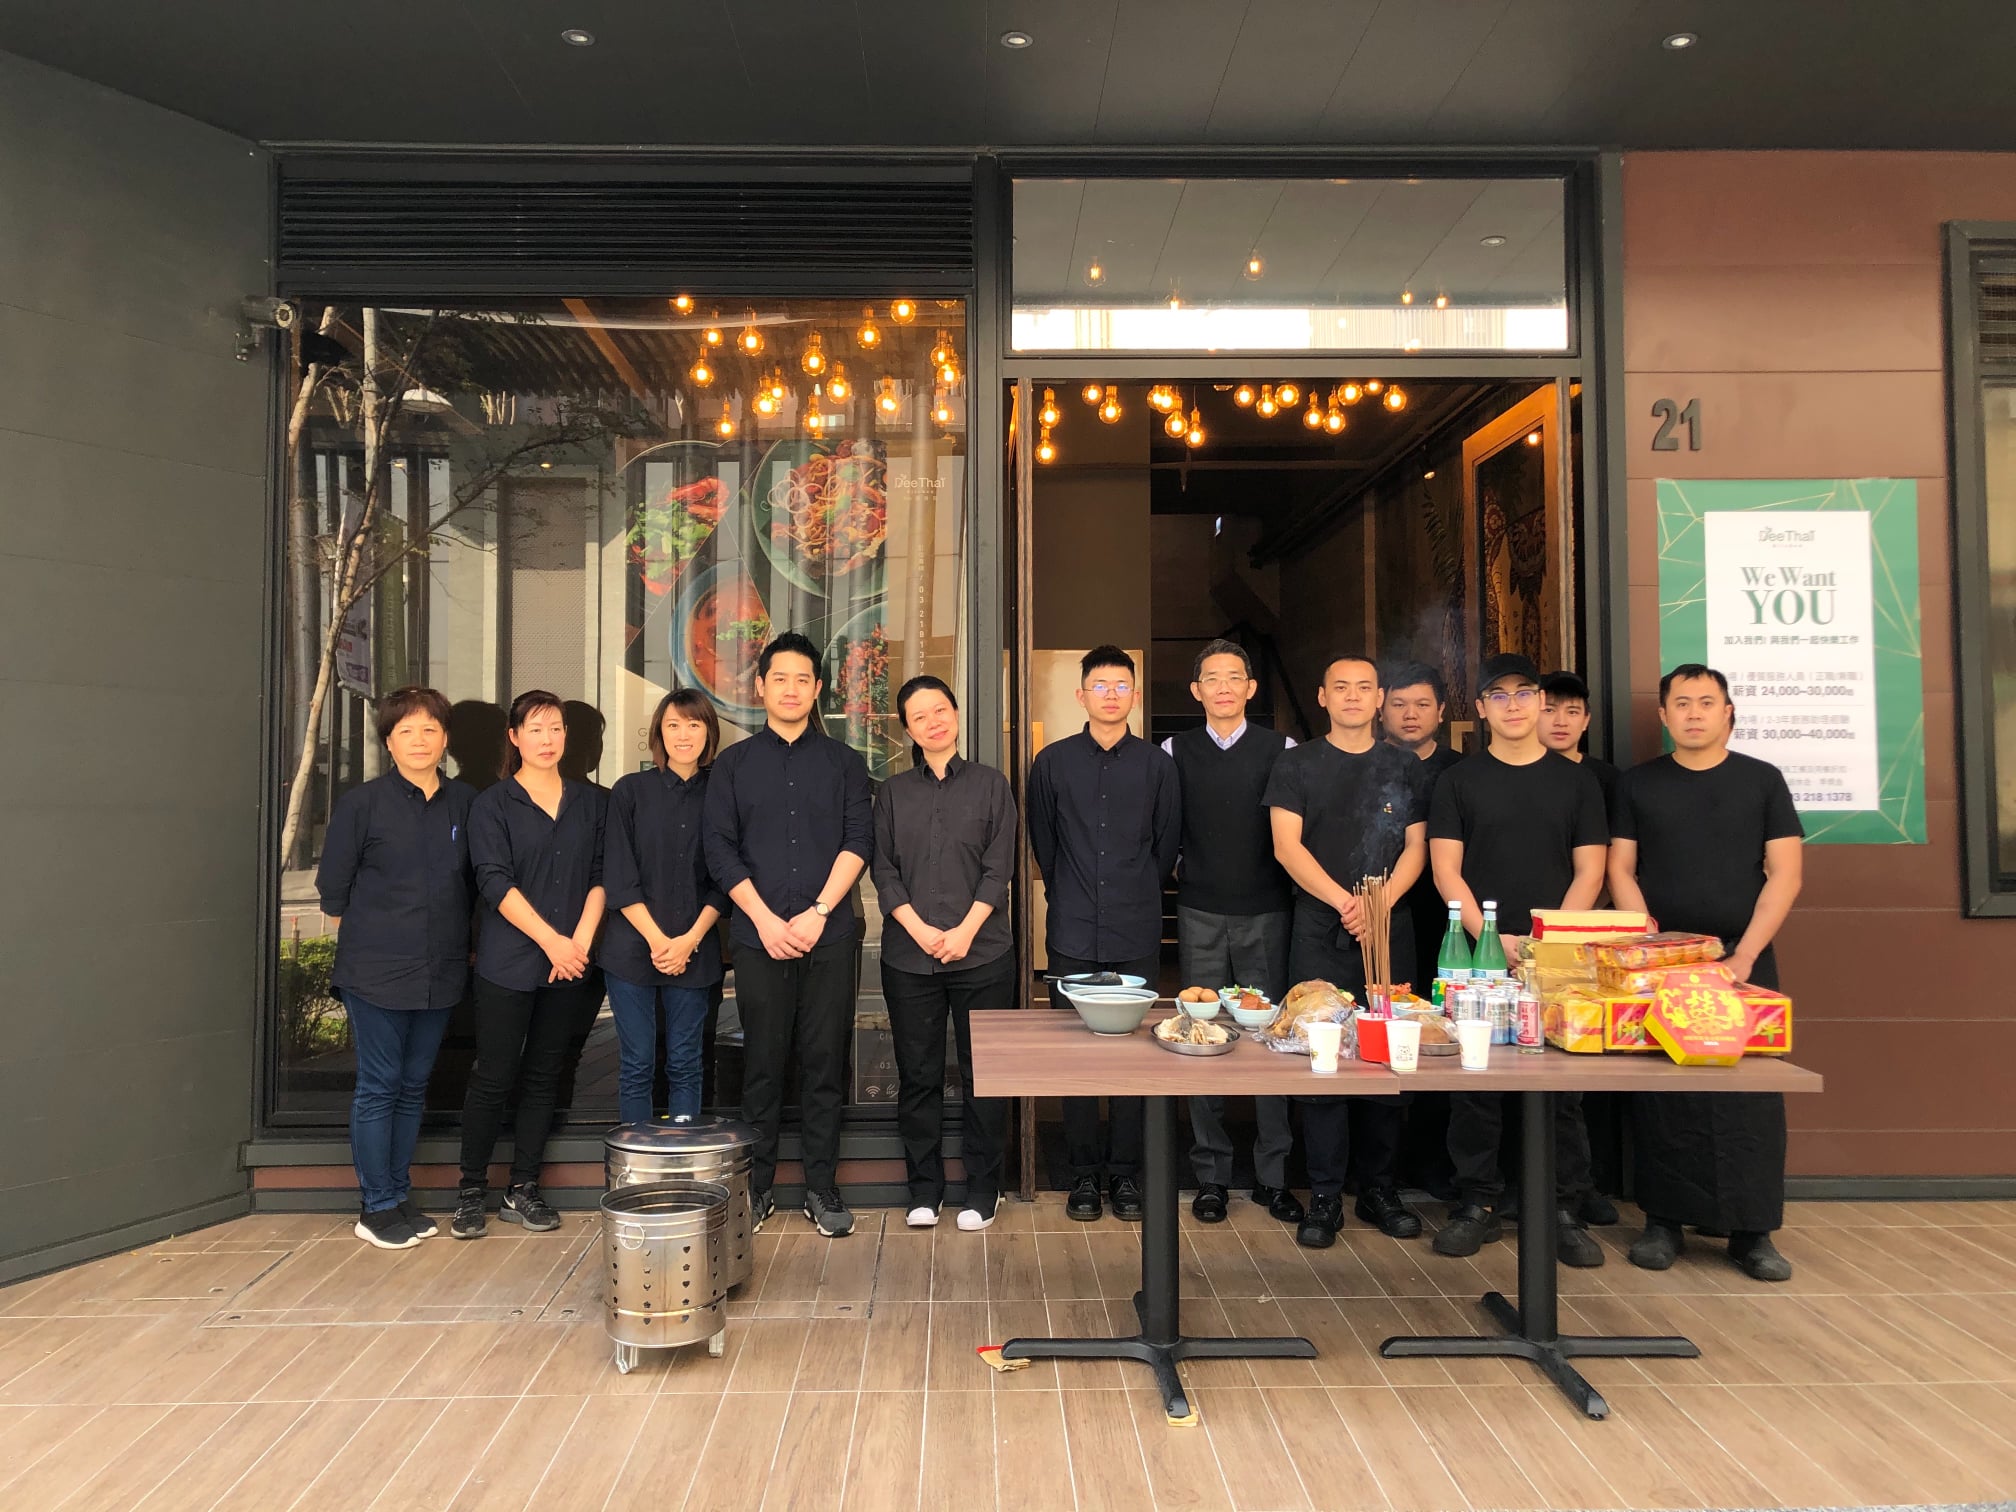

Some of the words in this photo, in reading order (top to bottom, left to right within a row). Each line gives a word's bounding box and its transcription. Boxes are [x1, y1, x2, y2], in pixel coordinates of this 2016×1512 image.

[1651, 398, 1701, 451] 21
[1740, 566, 1776, 587] We
[1778, 566, 1837, 587] Want
[1741, 589, 1837, 625] YOU
[1732, 685, 1757, 697] 薪資
[1734, 728, 1758, 740] 薪資
[1803, 792, 1824, 802] 218
[1826, 792, 1853, 802] 1378
